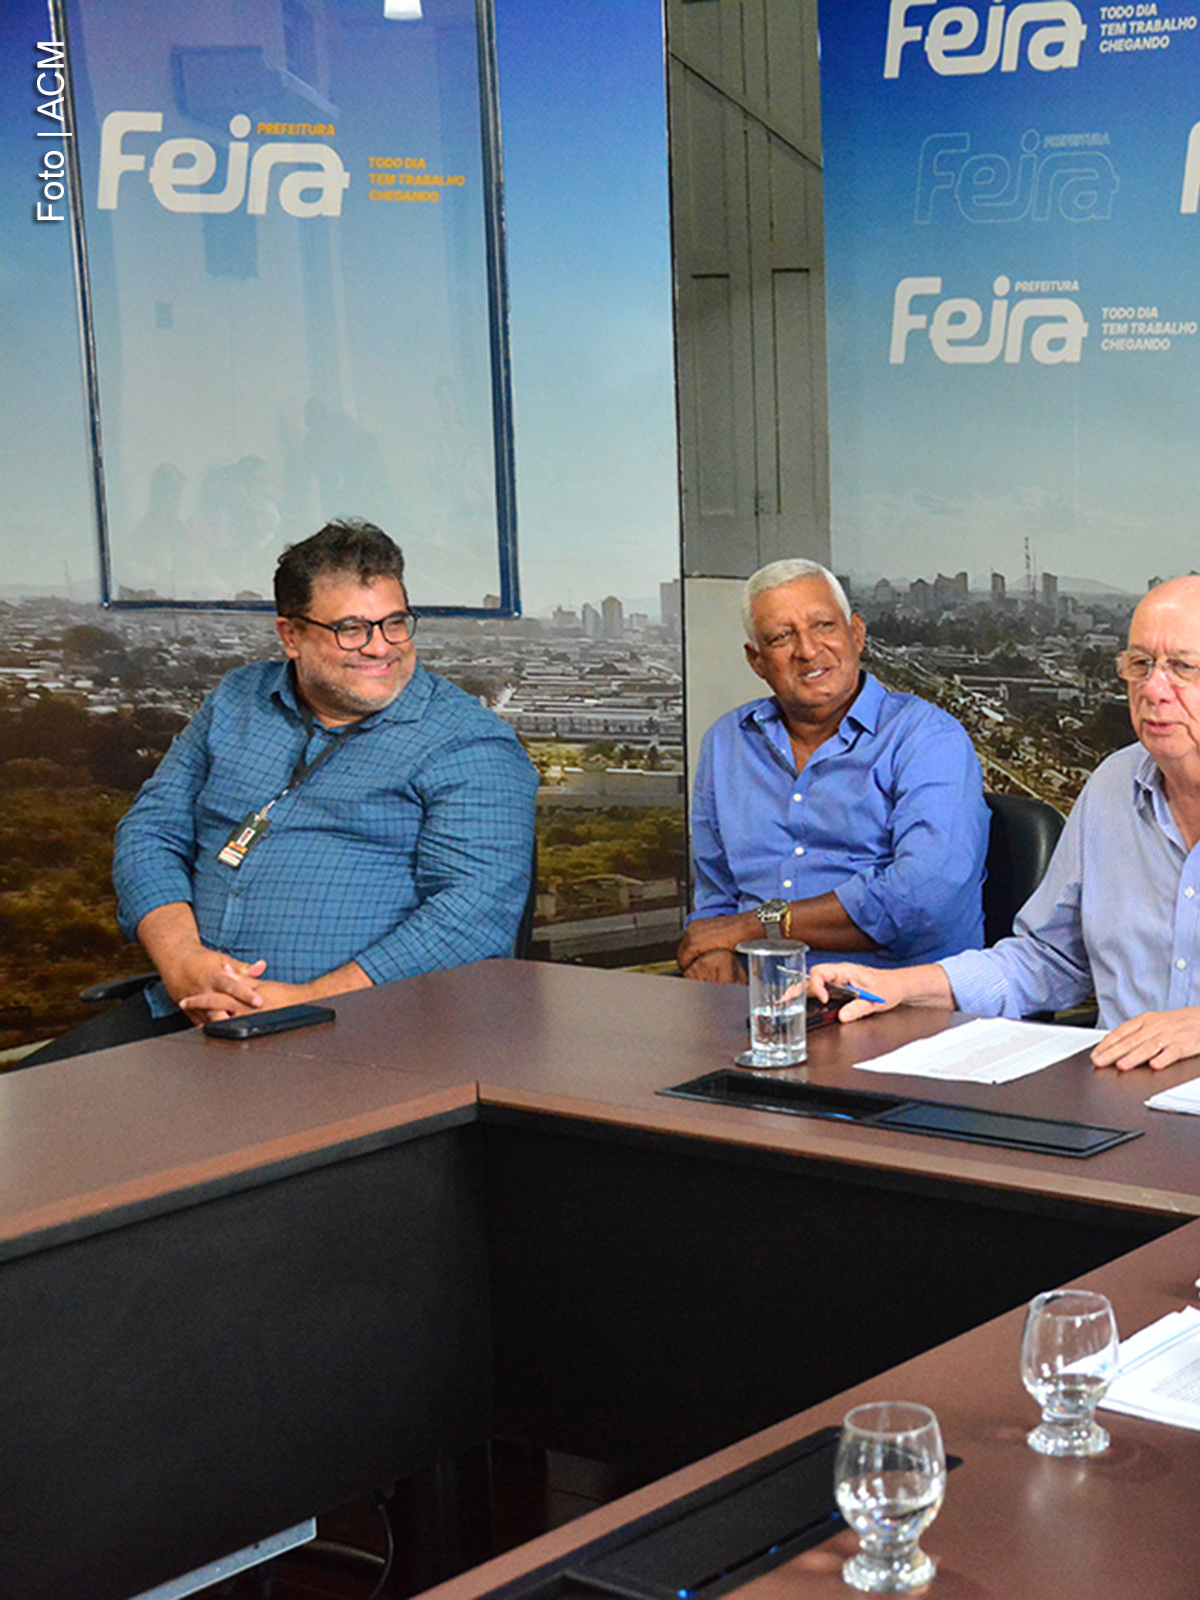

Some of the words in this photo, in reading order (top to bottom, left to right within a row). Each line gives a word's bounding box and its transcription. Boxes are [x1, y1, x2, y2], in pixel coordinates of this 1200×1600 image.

[1100, 4, 1135, 20] TODO
[1136, 3, 1158, 17] DIA
[1100, 21, 1127, 37] TEM
[1128, 16, 1198, 36] TRABALHO
[884, 0, 1087, 78] Feira
[1099, 35, 1170, 53] CHEGANDO
[256, 122, 336, 137] PREFEITURA
[97, 111, 350, 218] Feira
[368, 156, 402, 170] TODO
[403, 157, 427, 170] DIA
[368, 173, 396, 187] TEM
[397, 173, 466, 188] TRABALHO
[914, 129, 1120, 225] Feira
[368, 189, 440, 203] CHEGANDO
[1014, 280, 1080, 293] PREFEITURA
[889, 275, 1089, 365] Feira
[1101, 306, 1136, 320] TODO
[1136, 306, 1159, 320] DIA
[1101, 322, 1129, 335] TEM
[1129, 321, 1198, 335] TRABALHO
[1101, 337, 1171, 351] CHEGANDO
